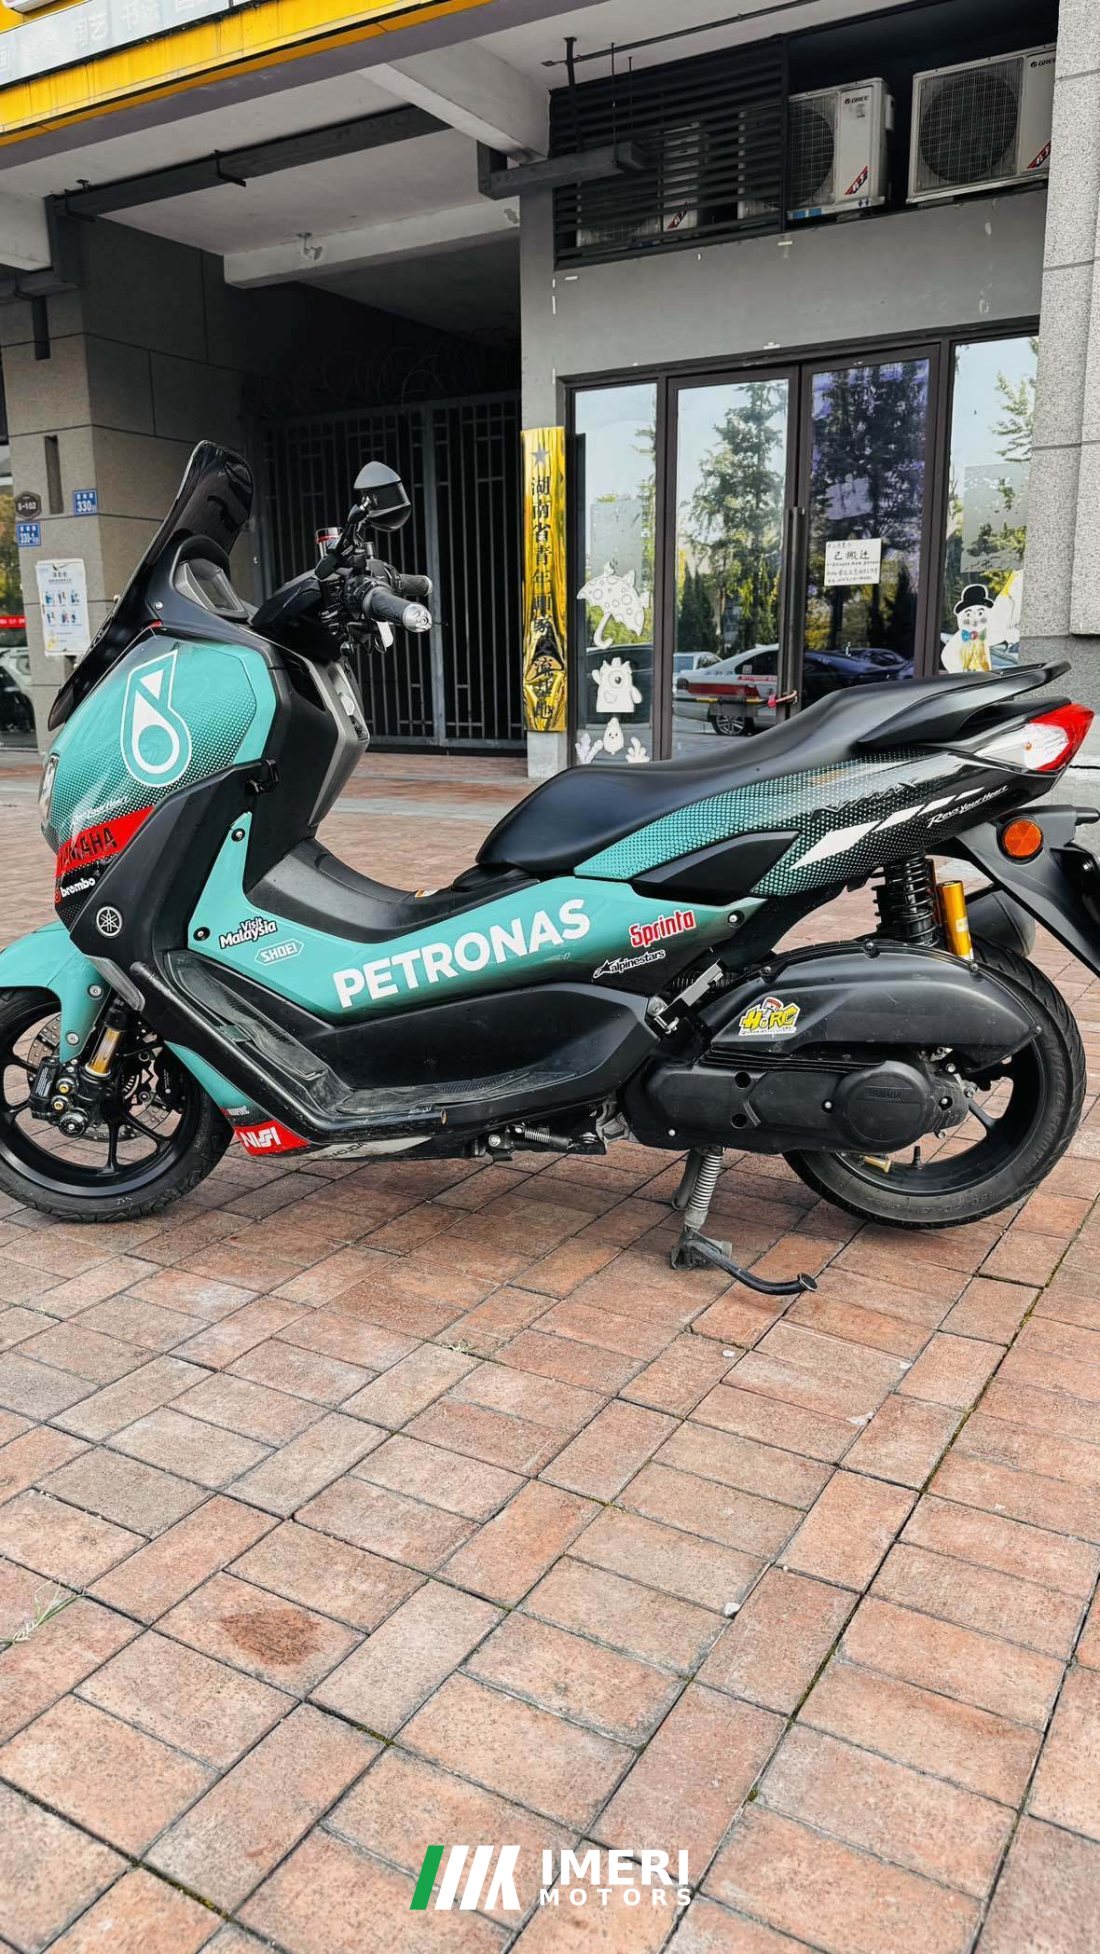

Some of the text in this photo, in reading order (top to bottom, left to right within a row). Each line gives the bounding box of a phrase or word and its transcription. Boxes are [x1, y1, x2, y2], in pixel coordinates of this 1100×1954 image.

[60, 877, 96, 898] brembo
[219, 920, 277, 949] Malaysia
[240, 917, 263, 931] Visit
[630, 910, 696, 947] Sprinta
[260, 942, 298, 963] SHOEI
[333, 899, 590, 1008] PETRONAS
[610, 949, 666, 974] alpinestars
